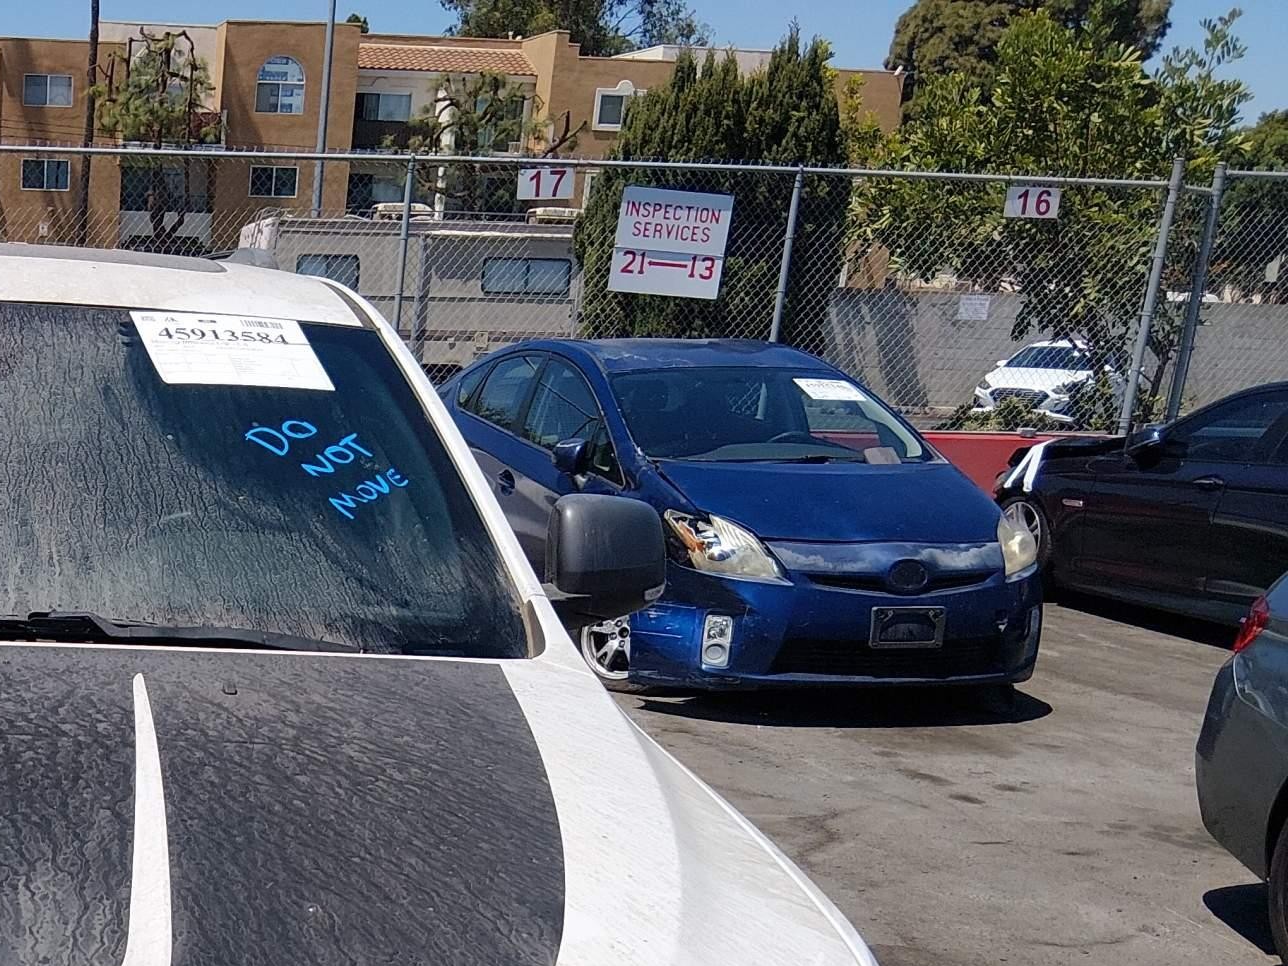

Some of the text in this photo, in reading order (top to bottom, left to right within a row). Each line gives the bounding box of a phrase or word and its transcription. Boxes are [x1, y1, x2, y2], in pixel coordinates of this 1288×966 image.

[529, 169, 568, 198] 17
[624, 199, 722, 225] INSPECTION
[1017, 188, 1052, 216] 16
[631, 220, 711, 243] SERVICES
[158, 326, 290, 345] 45913584
[245, 419, 318, 457] DO
[300, 432, 374, 477] NOT
[328, 467, 410, 520] MOVE
